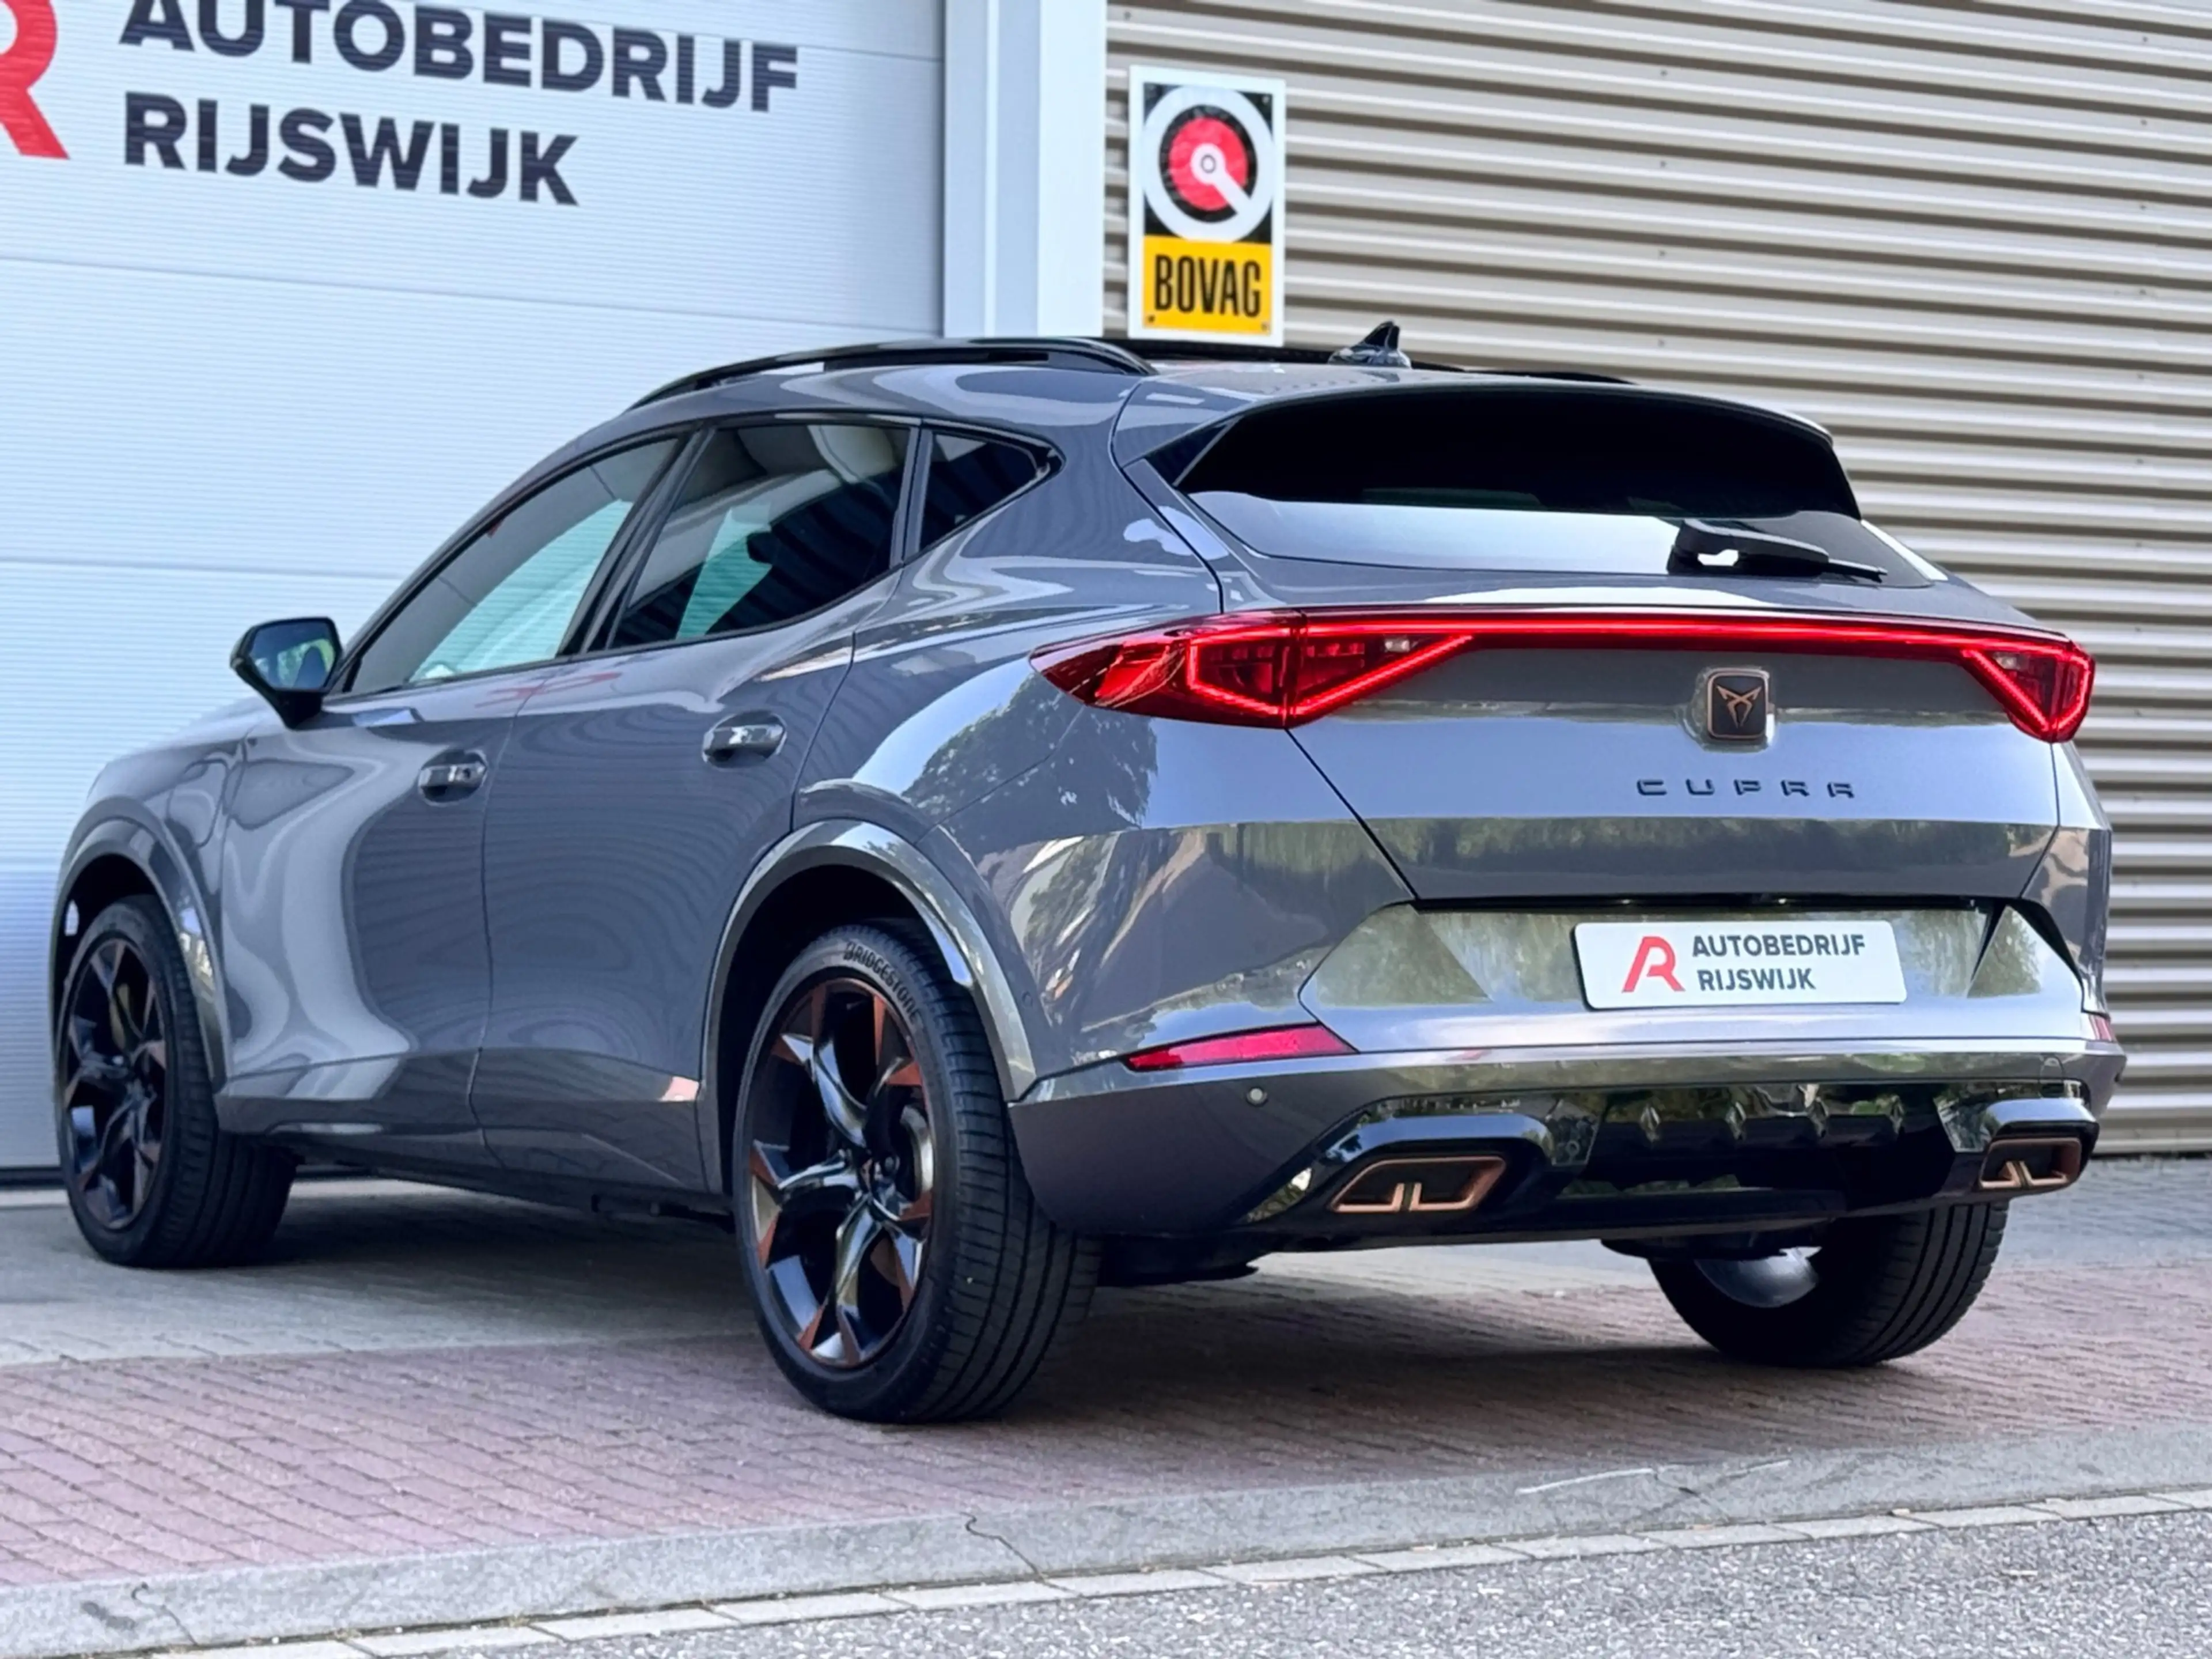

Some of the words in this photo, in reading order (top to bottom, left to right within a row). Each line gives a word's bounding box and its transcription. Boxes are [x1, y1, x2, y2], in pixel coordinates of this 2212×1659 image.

[119, 0, 797, 112] AUTOBEDRIJF
[124, 91, 579, 206] RIJSWIJK
[1155, 253, 1261, 318] BOVAG
[1637, 779, 1854, 798] CUPRA
[1692, 934, 1865, 957] AUTOBEDRIJF
[843, 941, 921, 1024] BRIDGESTONE
[1697, 968, 1816, 991] RIJSWIJK
